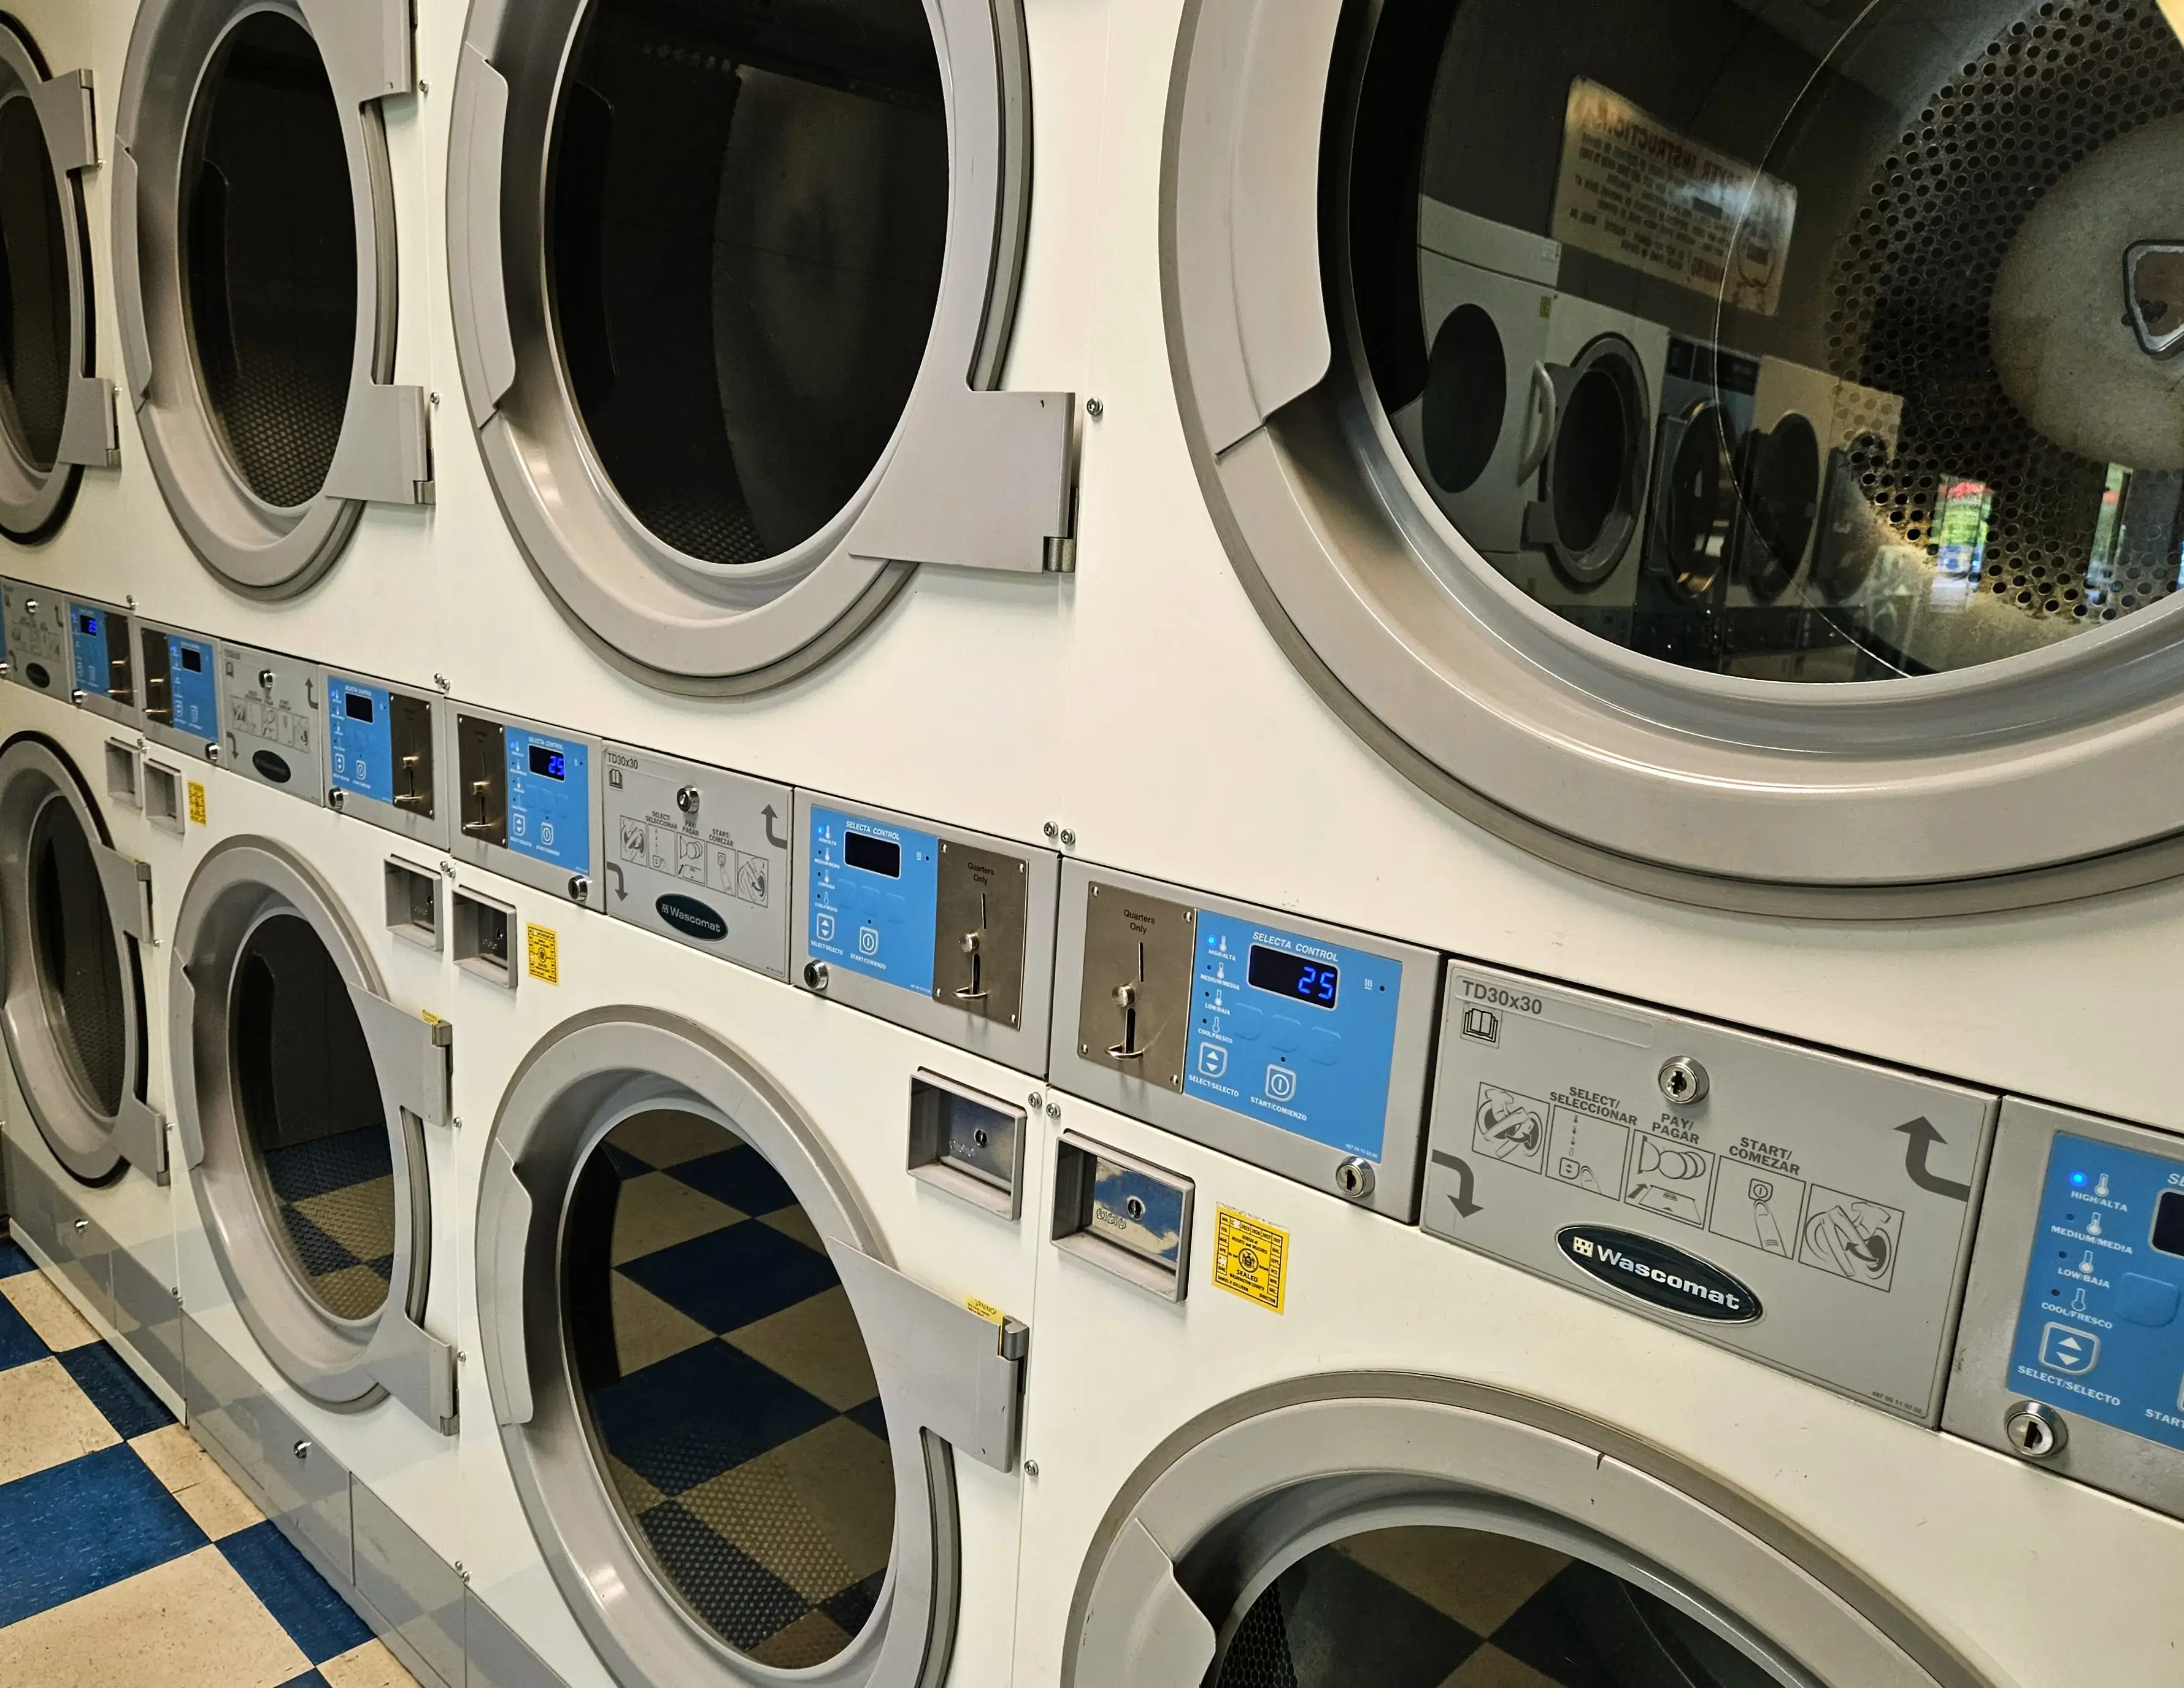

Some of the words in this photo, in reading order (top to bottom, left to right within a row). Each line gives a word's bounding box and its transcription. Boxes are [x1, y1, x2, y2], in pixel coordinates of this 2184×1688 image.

[607, 752, 638, 769] TD30x30
[682, 827, 699, 836] PAGAR
[709, 834, 734, 847] COMEZAR
[845, 821, 871, 832] SELECTA
[873, 828, 899, 840] CONTROL
[968, 862, 994, 876] Quarters
[974, 874, 988, 886] Only
[670, 906, 720, 933] Wascomat
[1124, 909, 1155, 924] Quarters
[1130, 923, 1147, 935] Only
[1253, 931, 1291, 949] SELECTA
[1296, 944, 1339, 962] CONTROL
[1298, 966, 1334, 999] 25
[1463, 980, 1542, 1015] TD30x30
[1198, 1028, 1233, 1044] COOL/FRESCO
[1188, 1075, 1239, 1097] SELECT/SELECTO
[1569, 1086, 1620, 1108] SELECT/
[1250, 1097, 1307, 1121] START/COMIENZO
[1550, 1092, 1637, 1125] SELECCIONAR
[1661, 1113, 1694, 1130] PAY/
[1652, 1122, 1699, 1144] PAGAR
[1740, 1137, 1793, 1160] START/
[1729, 1146, 1800, 1176] COMEZAR
[2071, 1190, 2128, 1212] HIGH/ALTA
[2051, 1225, 2132, 1254] MEDIUM/MEDIA
[1237, 1269, 1258, 1282] SEALED
[1597, 1245, 1740, 1310] Wascomat
[2058, 1268, 2110, 1289] LOW/BAJA
[2041, 1302, 2113, 1329] COOL/FRESCO
[2018, 1365, 2120, 1406] SELECT/SELECTO
